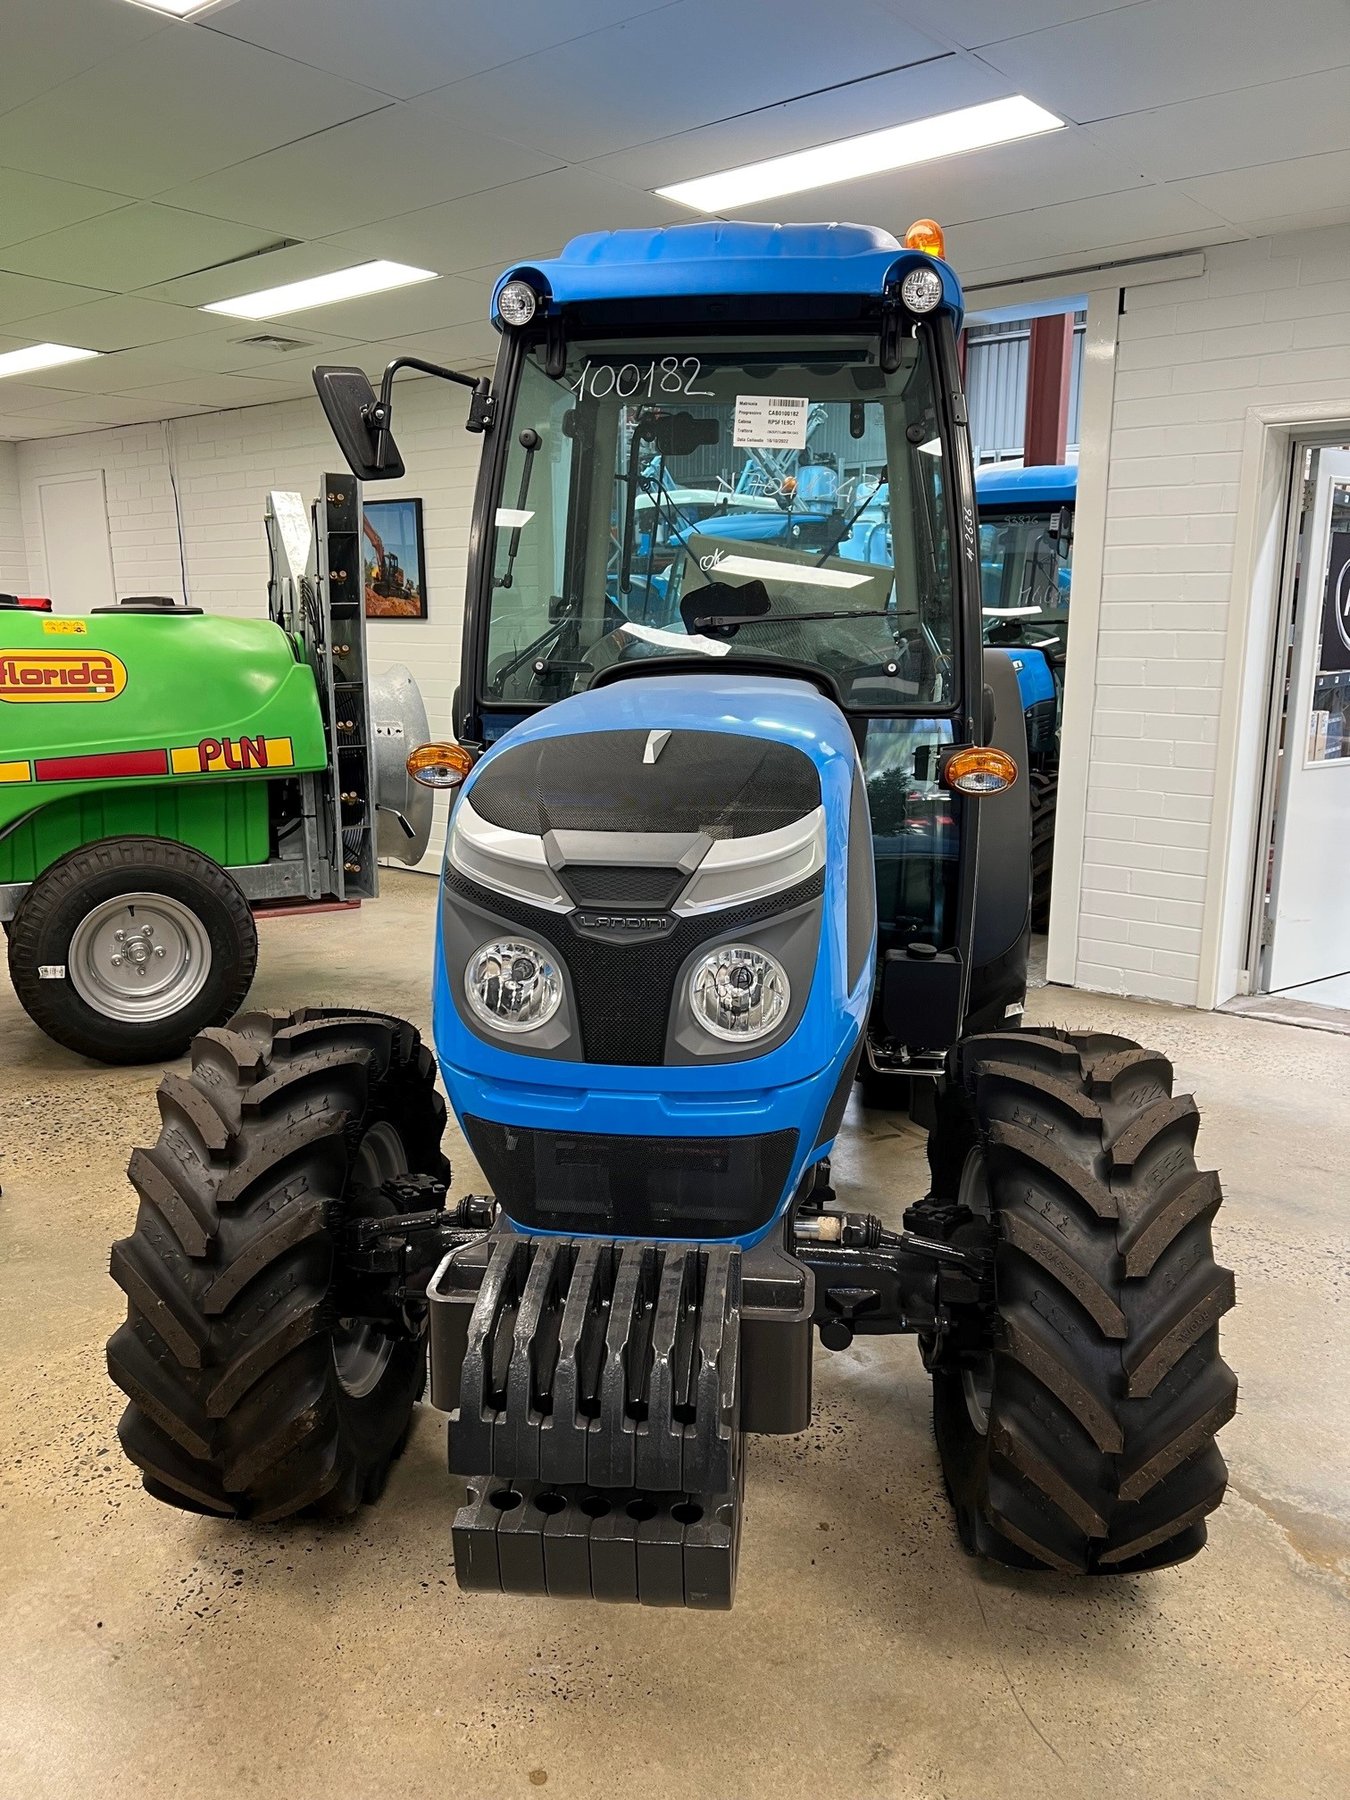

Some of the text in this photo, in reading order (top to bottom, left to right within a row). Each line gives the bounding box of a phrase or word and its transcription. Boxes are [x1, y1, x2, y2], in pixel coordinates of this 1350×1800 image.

[570, 356, 716, 402] 100182
[198, 735, 268, 772] PLN
[580, 916, 667, 929] LANDINI
